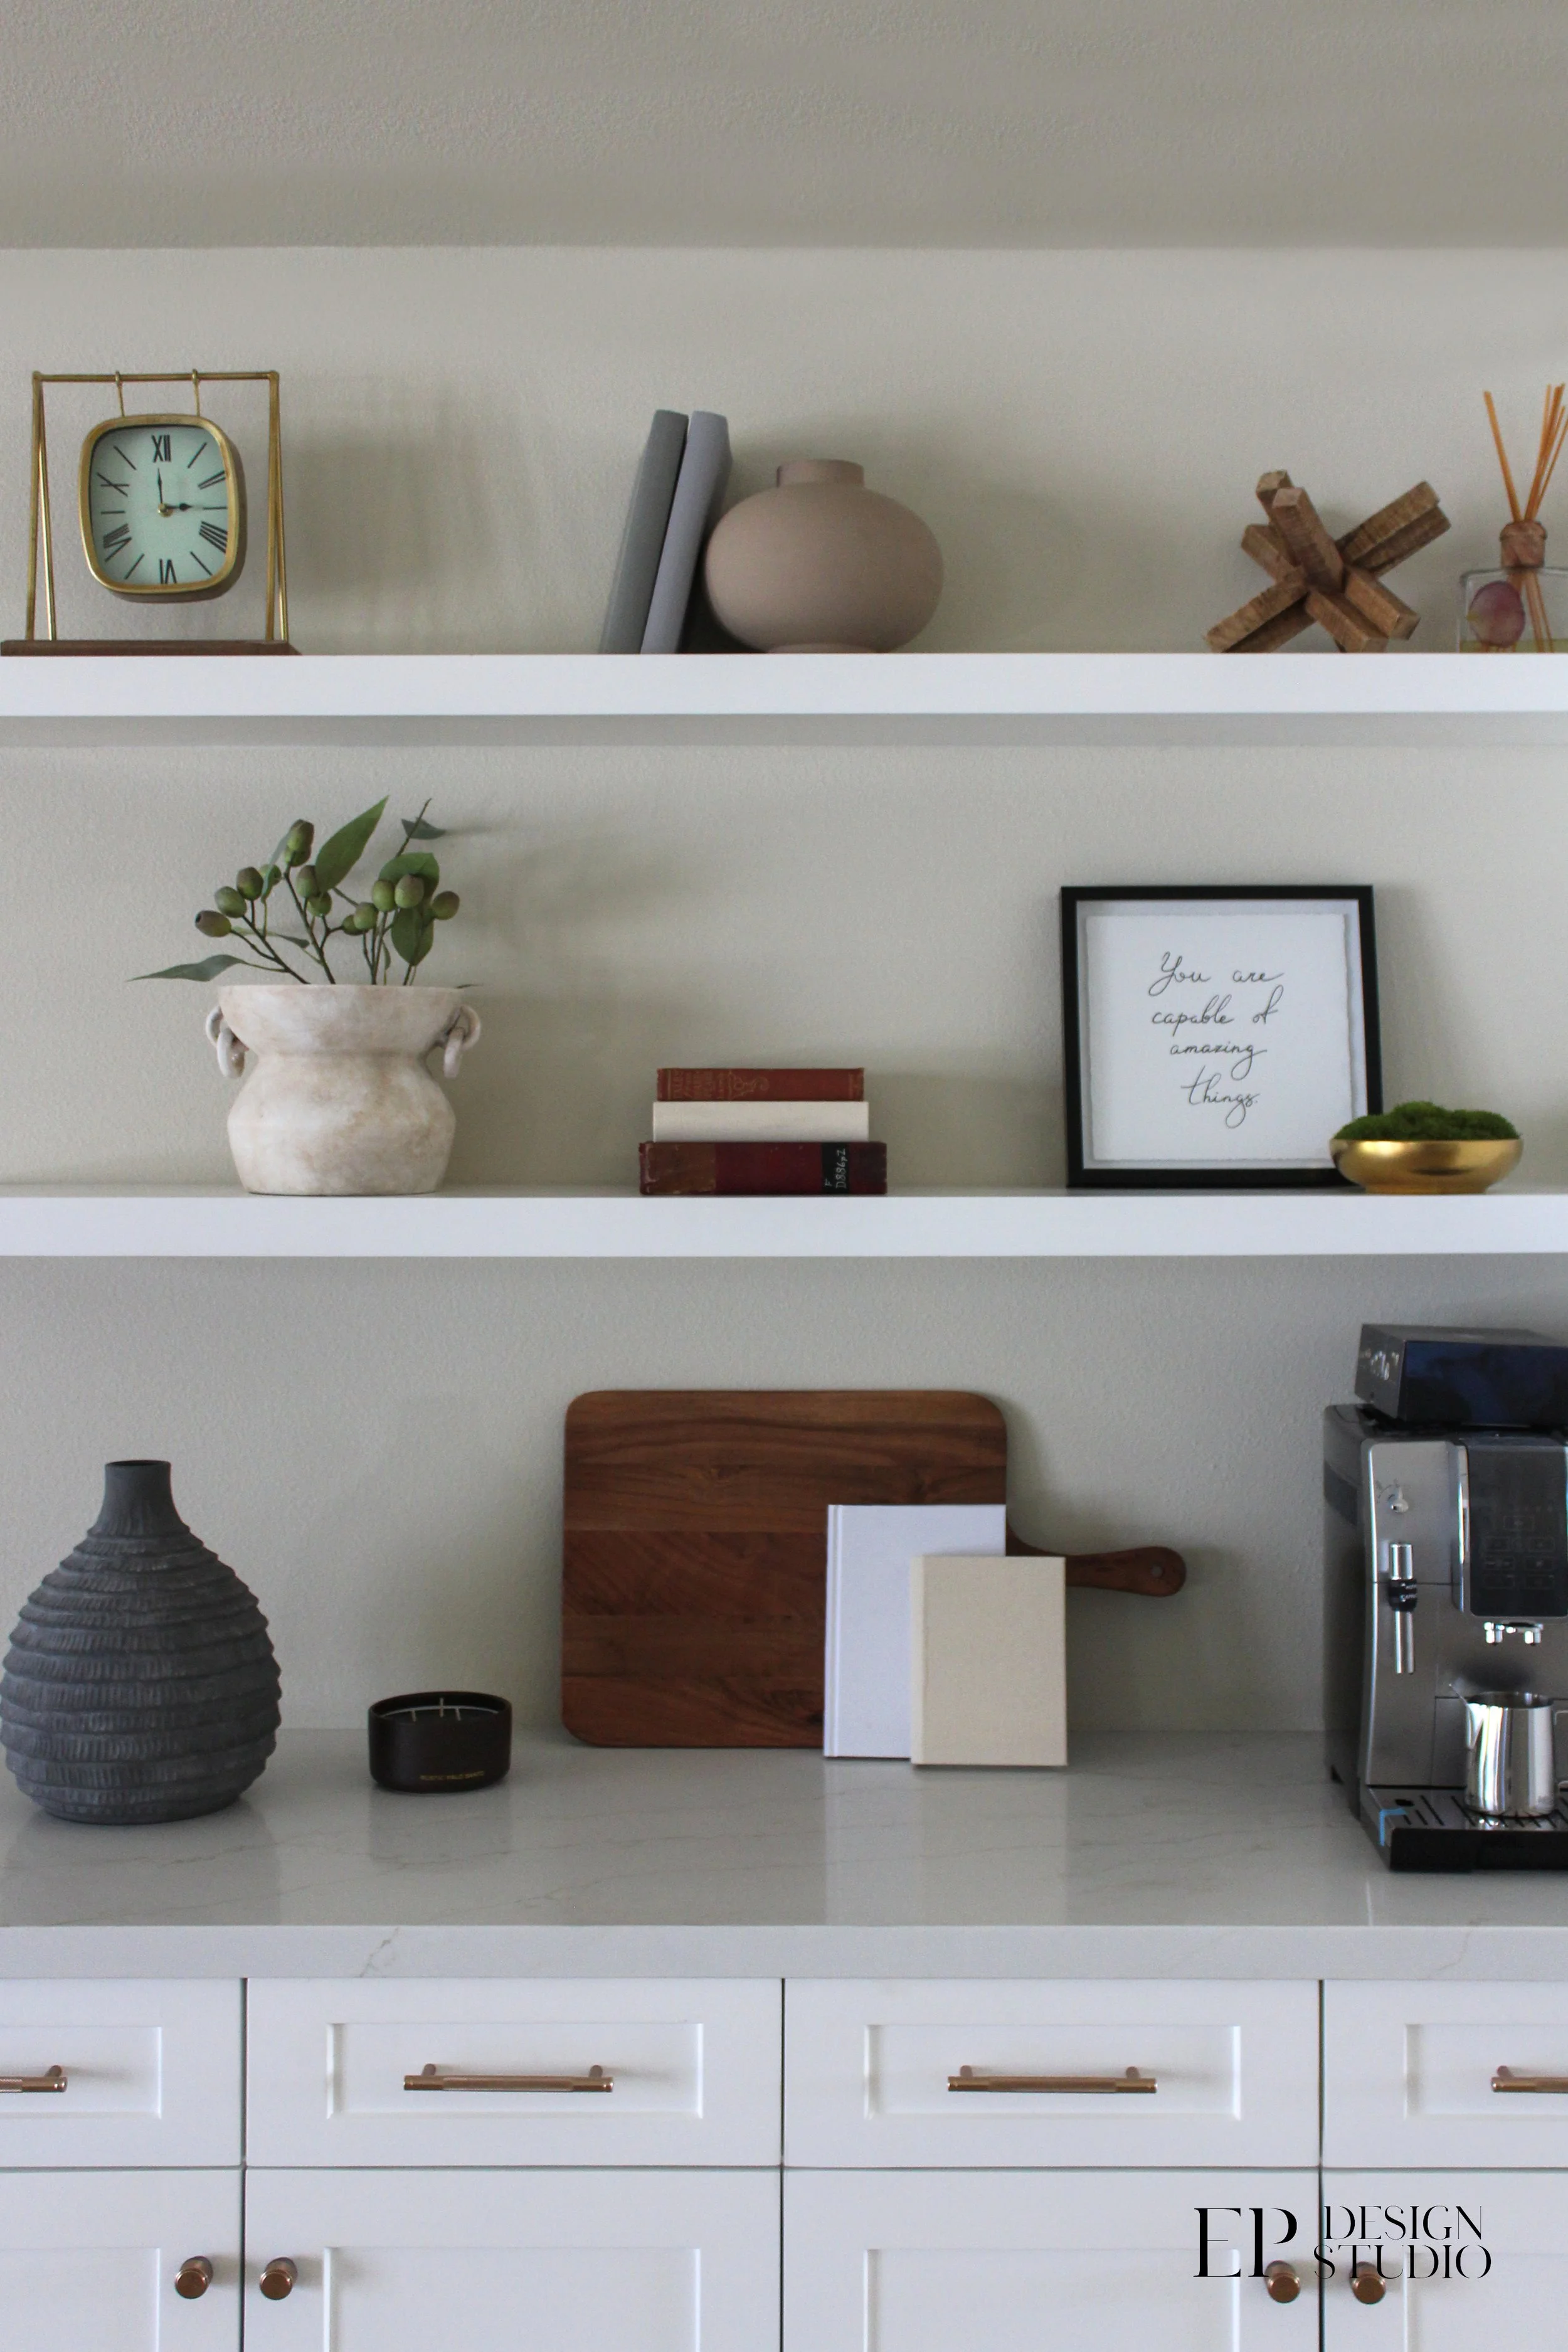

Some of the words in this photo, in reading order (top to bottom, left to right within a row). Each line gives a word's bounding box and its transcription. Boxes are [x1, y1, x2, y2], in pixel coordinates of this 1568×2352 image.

[152, 435, 171, 463] XII
[1148, 951, 1211, 996] You
[1232, 970, 1285, 983] are
[1152, 994, 1235, 1036] capable
[1253, 985, 1284, 1024] of
[1170, 1041, 1268, 1081] amazing
